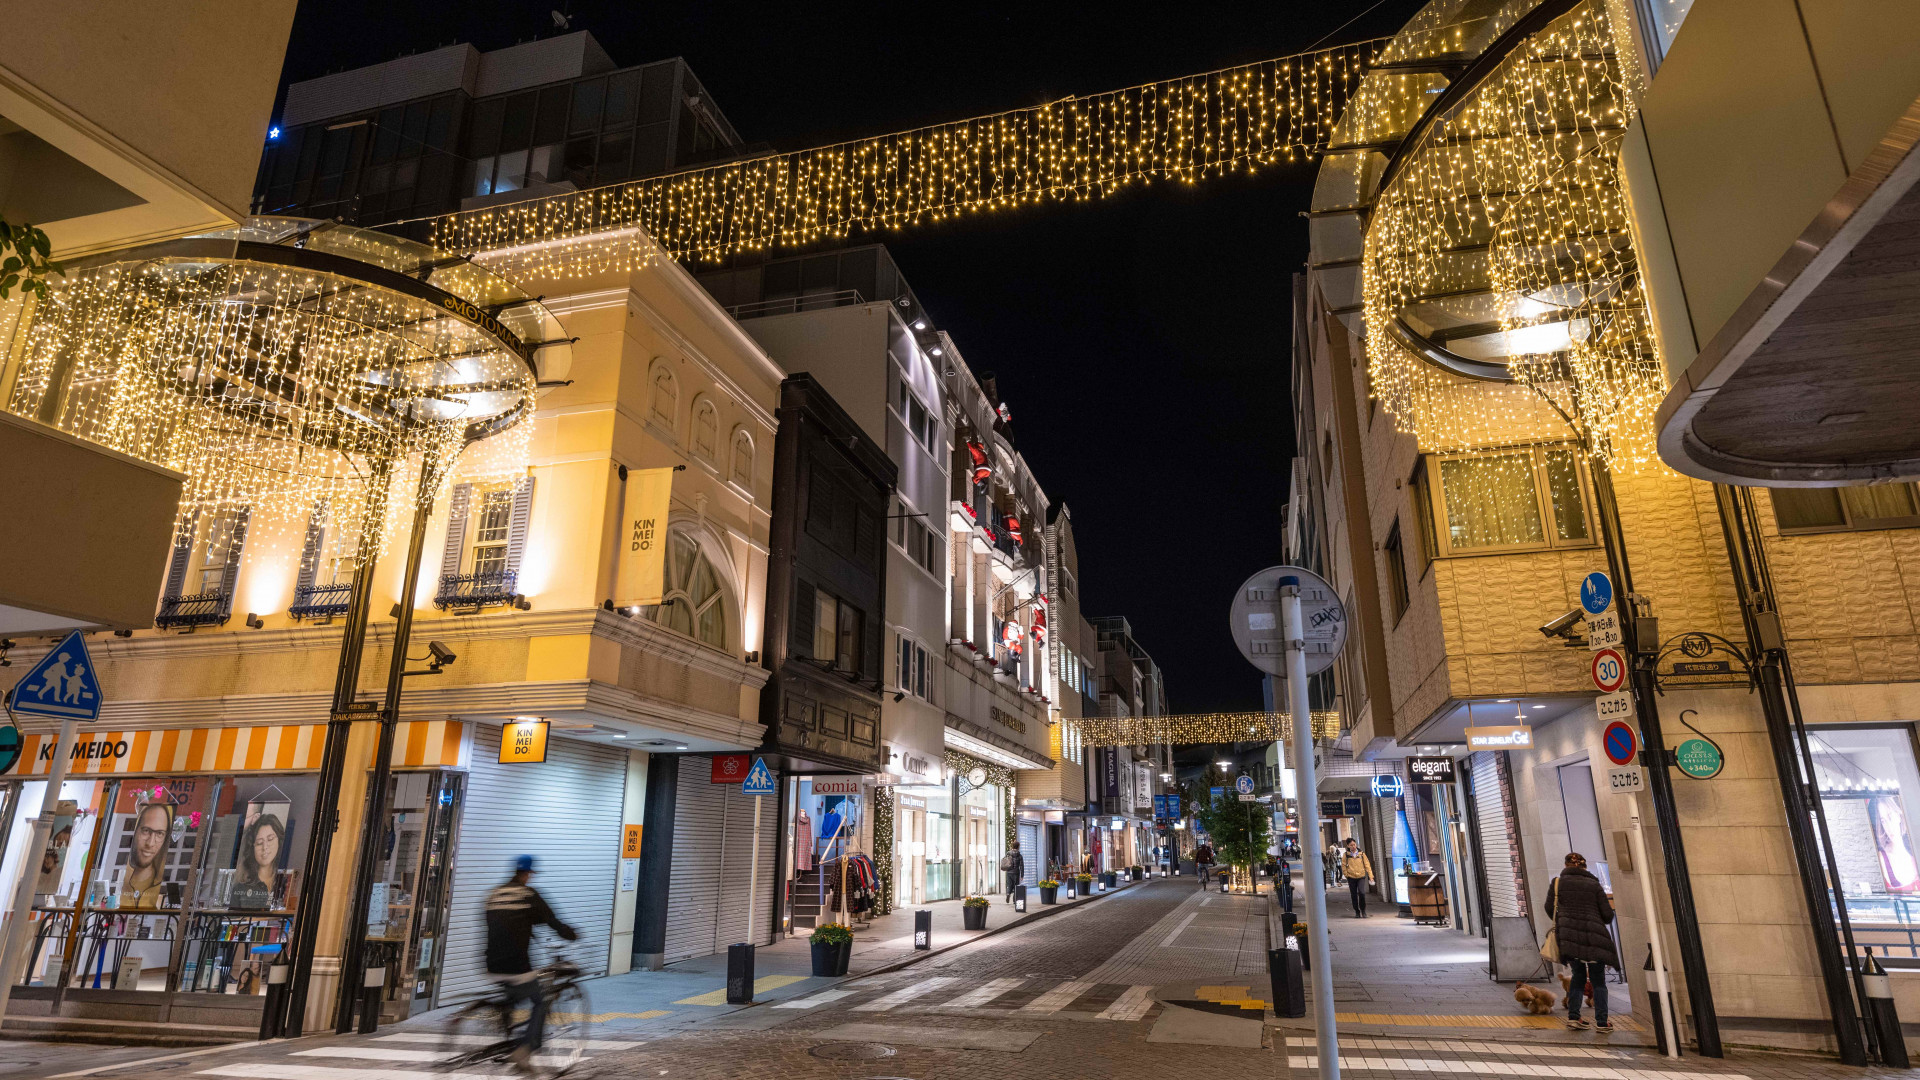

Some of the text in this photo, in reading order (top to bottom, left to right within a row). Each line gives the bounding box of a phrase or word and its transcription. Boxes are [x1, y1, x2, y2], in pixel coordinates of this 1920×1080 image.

[633, 518, 655, 530] KIN
[632, 529, 654, 541] MEI
[631, 540, 650, 551] DO
[1599, 660, 1618, 681] 30
[1600, 698, 1628, 715] ここから
[517, 728, 533, 737] KIN
[515, 737, 532, 746] MEI
[40, 740, 128, 761] KIMEIDO
[514, 746, 529, 755] DO
[1107, 752, 1115, 787] KAGURA
[1412, 758, 1451, 775] elegant
[170, 780, 196, 792] MEI
[814, 779, 858, 793] comia
[1612, 772, 1639, 787] ここから
[167, 792, 189, 805] DO
